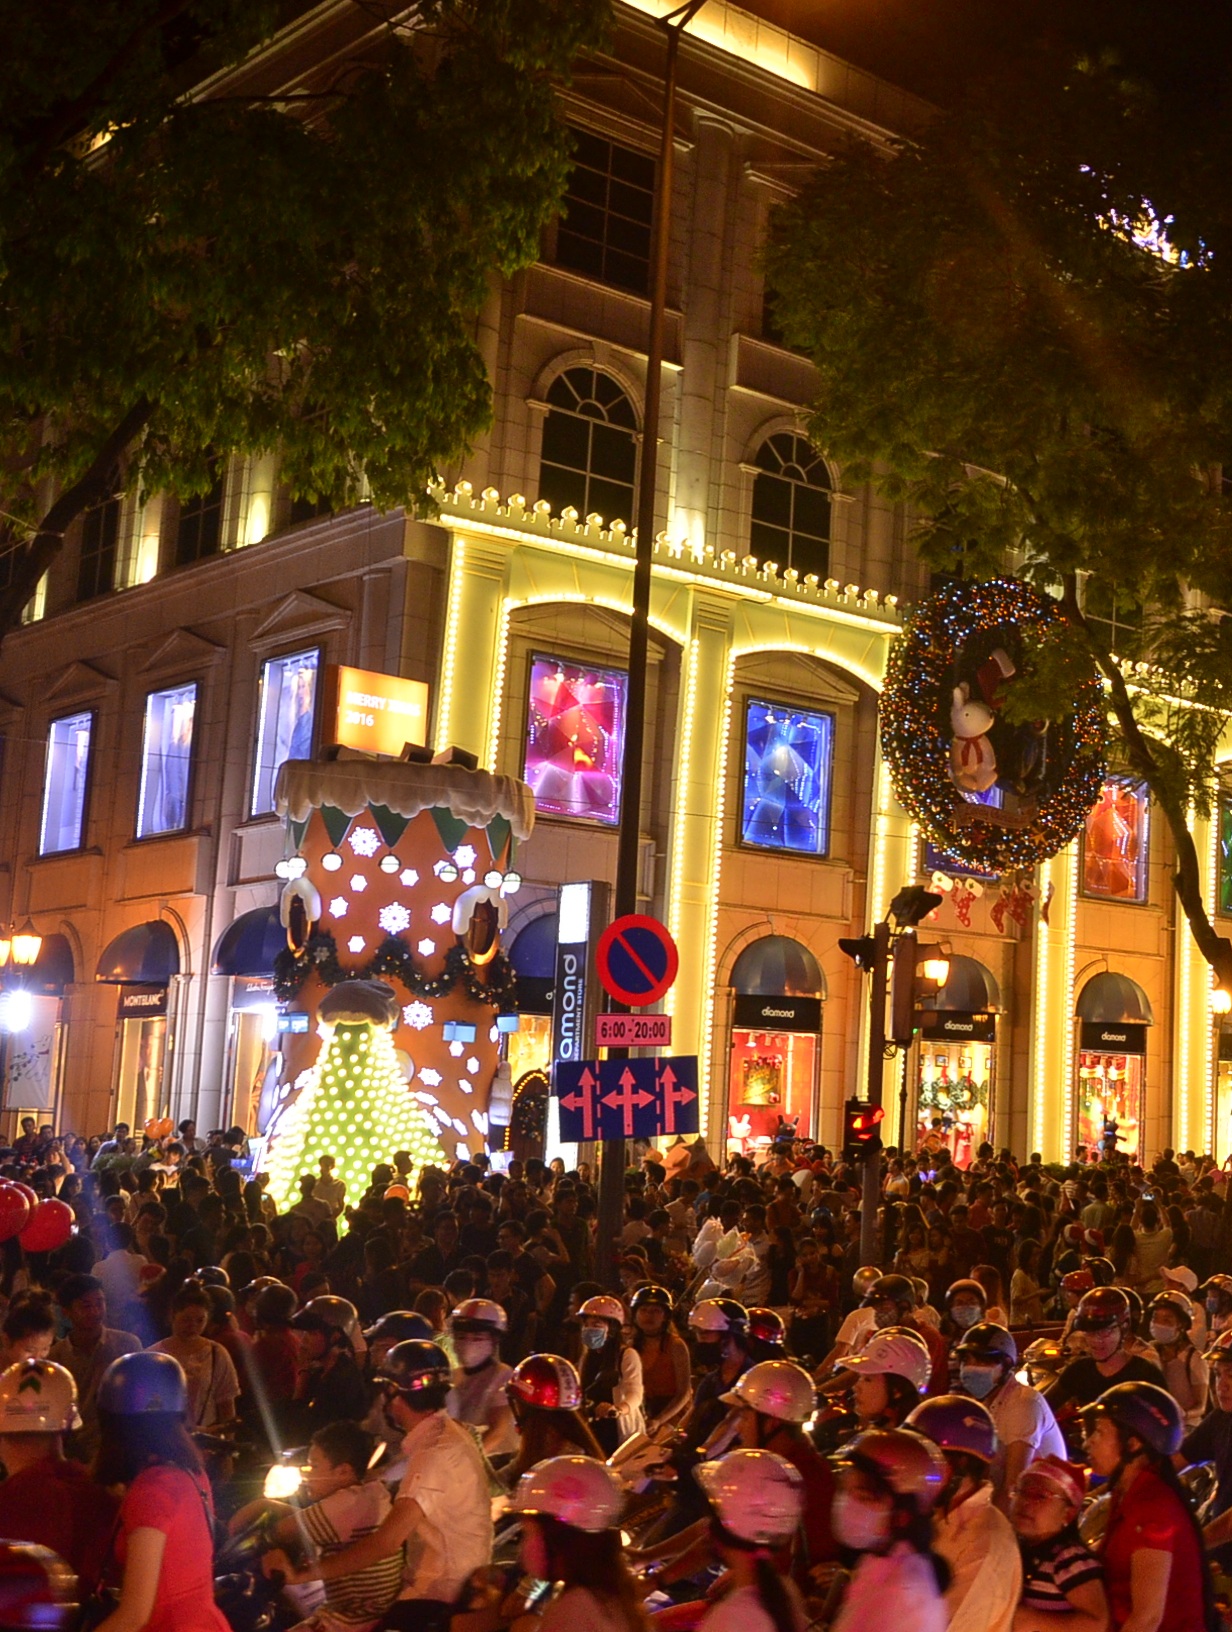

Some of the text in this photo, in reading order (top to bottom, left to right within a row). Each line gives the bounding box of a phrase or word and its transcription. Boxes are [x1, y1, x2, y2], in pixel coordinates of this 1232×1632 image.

[345, 691, 387, 710] MERRY
[344, 710, 375, 727] 2016
[124, 993, 161, 1007] MONTBLANC
[761, 1005, 795, 1018] diamond
[601, 1021, 626, 1038] 6:00
[634, 1021, 666, 1038] 20:00
[944, 1020, 974, 1032] diamond
